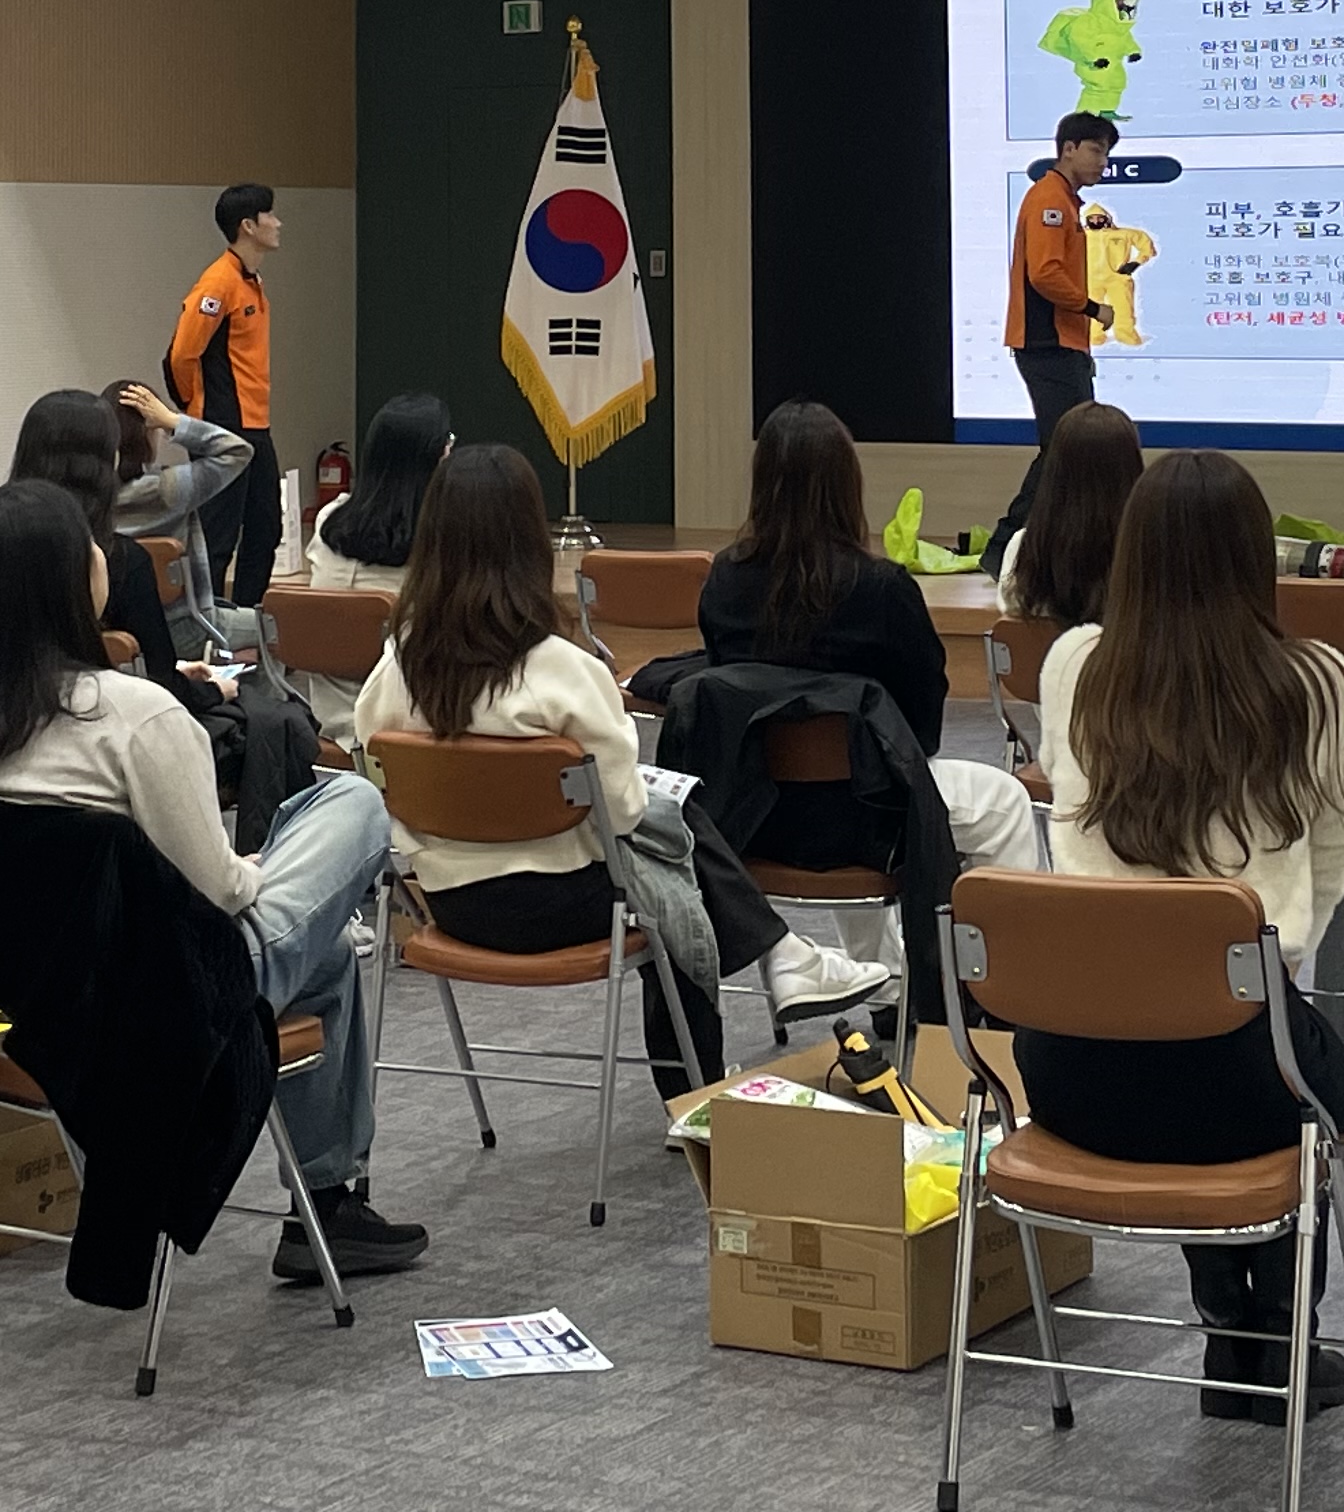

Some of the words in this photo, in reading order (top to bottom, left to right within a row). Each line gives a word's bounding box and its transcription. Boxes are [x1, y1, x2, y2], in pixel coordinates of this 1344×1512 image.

[1201, 0, 1252, 19] 대한
[1200, 75, 1258, 91] 고위험
[1268, 73, 1328, 89] 병원체
[1201, 94, 1282, 110] 의심장소
[1123, 163, 1140, 178] C
[1205, 200, 1262, 220] 피부,
[1205, 221, 1283, 239] 보호가
[1292, 221, 1344, 239] 필요
[1205, 270, 1245, 285] 호흡
[1203, 291, 1262, 307] 고위험
